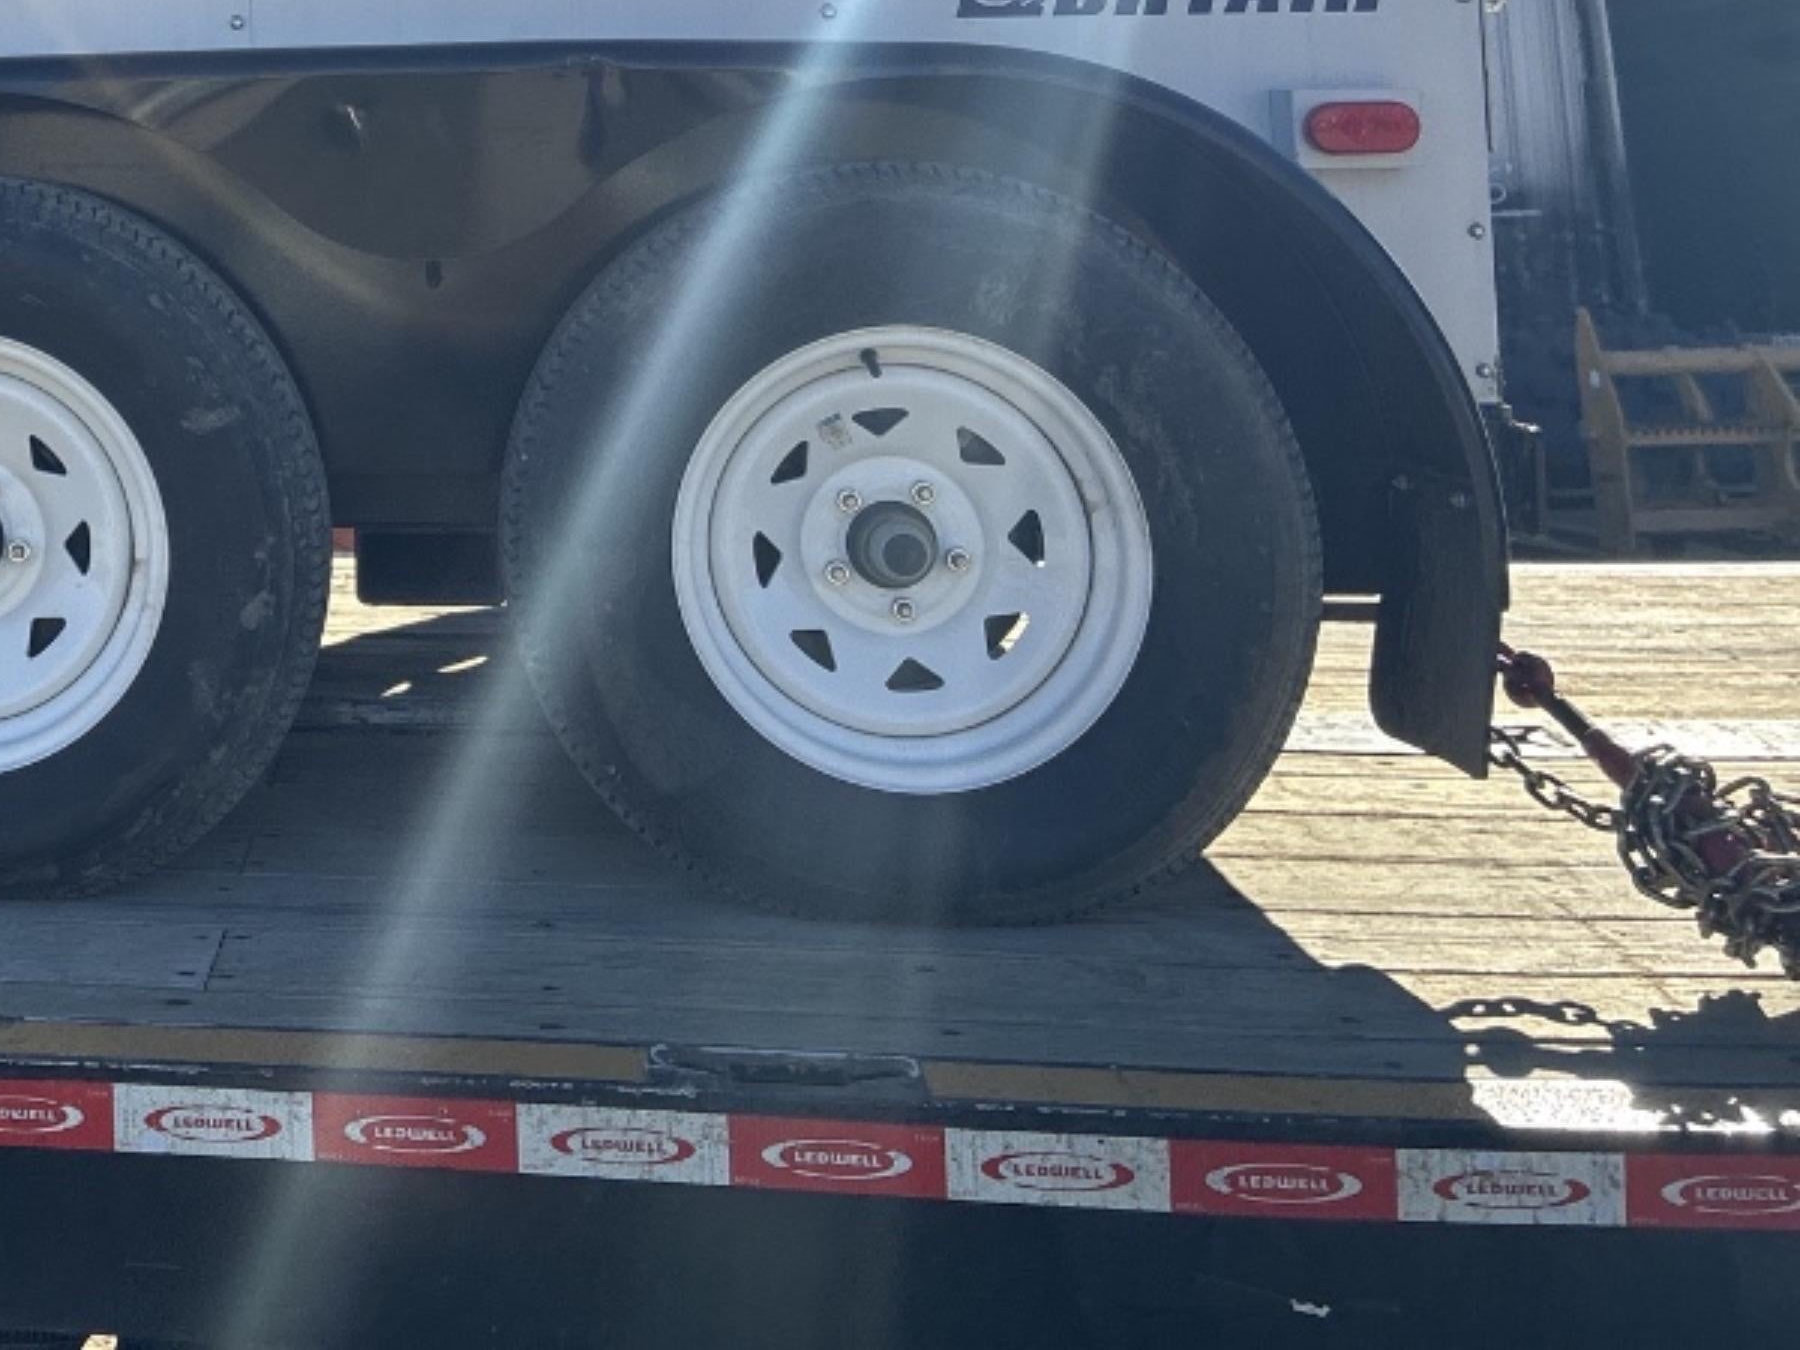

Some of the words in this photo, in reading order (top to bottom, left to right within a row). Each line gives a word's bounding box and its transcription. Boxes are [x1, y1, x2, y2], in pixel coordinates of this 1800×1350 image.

[374, 1125, 455, 1142] LEDWELL
[794, 1149, 881, 1168] LEDWELL
[1013, 1162, 1103, 1180] LEDWELL
[1239, 1175, 1329, 1191] LEDWELL
[1465, 1183, 1558, 1197] LEDWELL
